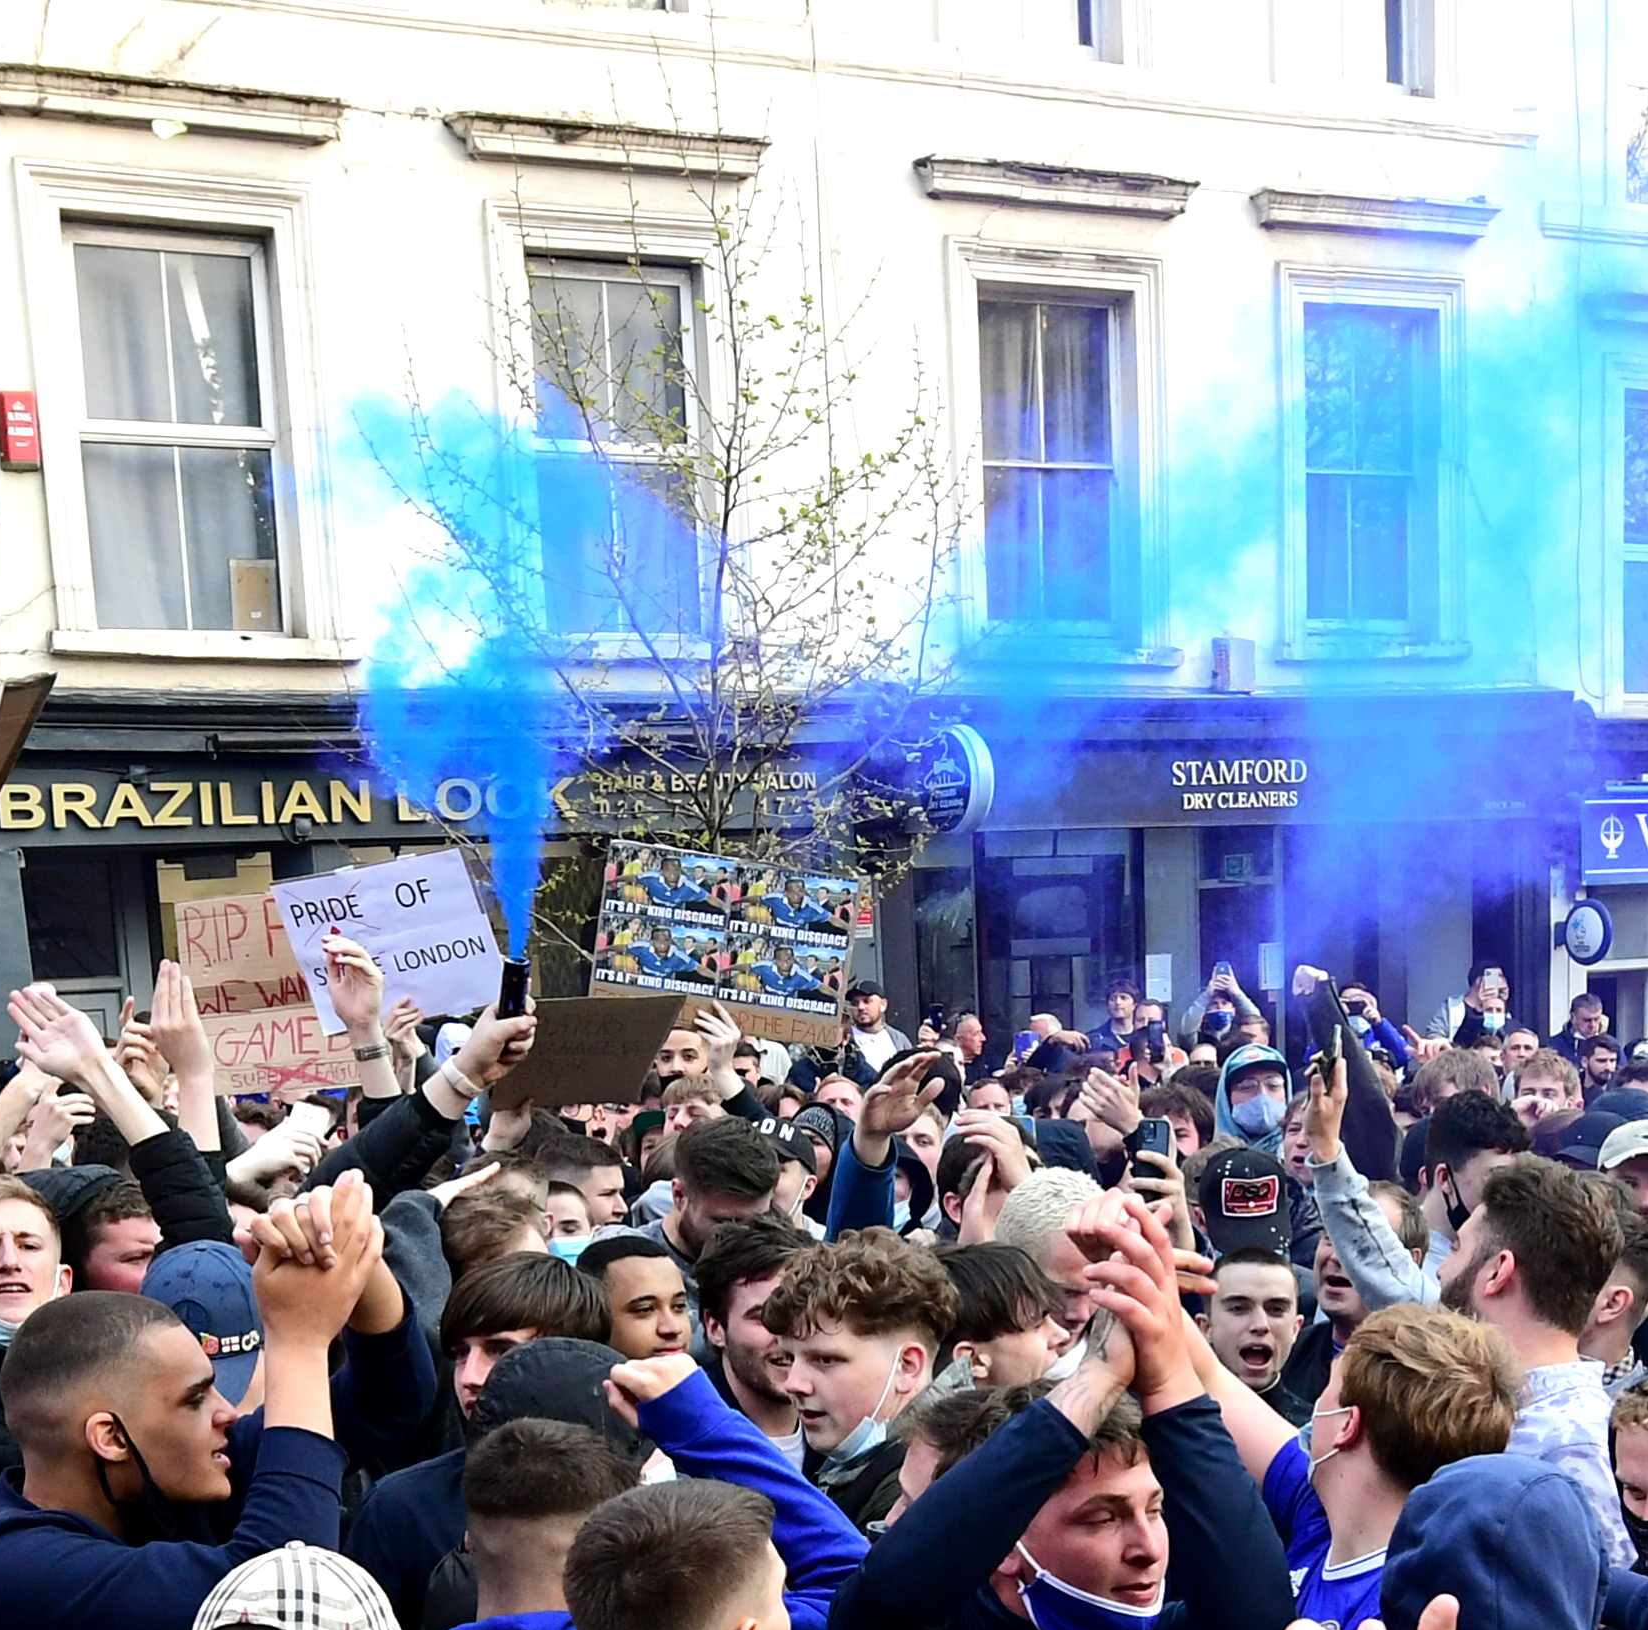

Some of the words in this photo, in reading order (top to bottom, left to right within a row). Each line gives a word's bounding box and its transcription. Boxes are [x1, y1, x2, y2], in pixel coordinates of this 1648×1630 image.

[599, 774, 645, 792] HAIR
[653, 773, 666, 793] &
[1171, 759, 1308, 786] STAMFORD
[396, 776, 580, 822] LOOK
[1182, 792, 1215, 810] DRY
[1217, 790, 1298, 809] CLEANERS
[289, 894, 363, 928] PRIDE
[395, 878, 431, 908] OF
[605, 899, 624, 912] IT'S
[626, 902, 633, 912] A
[674, 909, 725, 926] DISGRACE
[729, 919, 748, 933] IT'S
[750, 922, 758, 934] A
[798, 927, 847, 947] DISGRACE
[394, 935, 486, 973] LONDON
[595, 968, 614, 981] IT'S
[616, 971, 624, 982] A
[664, 978, 714, 996] DISGRACE
[195, 980, 251, 1014] WE
[719, 987, 738, 1001] IT'S
[739, 991, 747, 1002] A
[786, 996, 836, 1015] DISGRACE
[214, 1016, 319, 1066] GAME
[752, 1015, 782, 1035] THE
[791, 1018, 840, 1047] FANS
